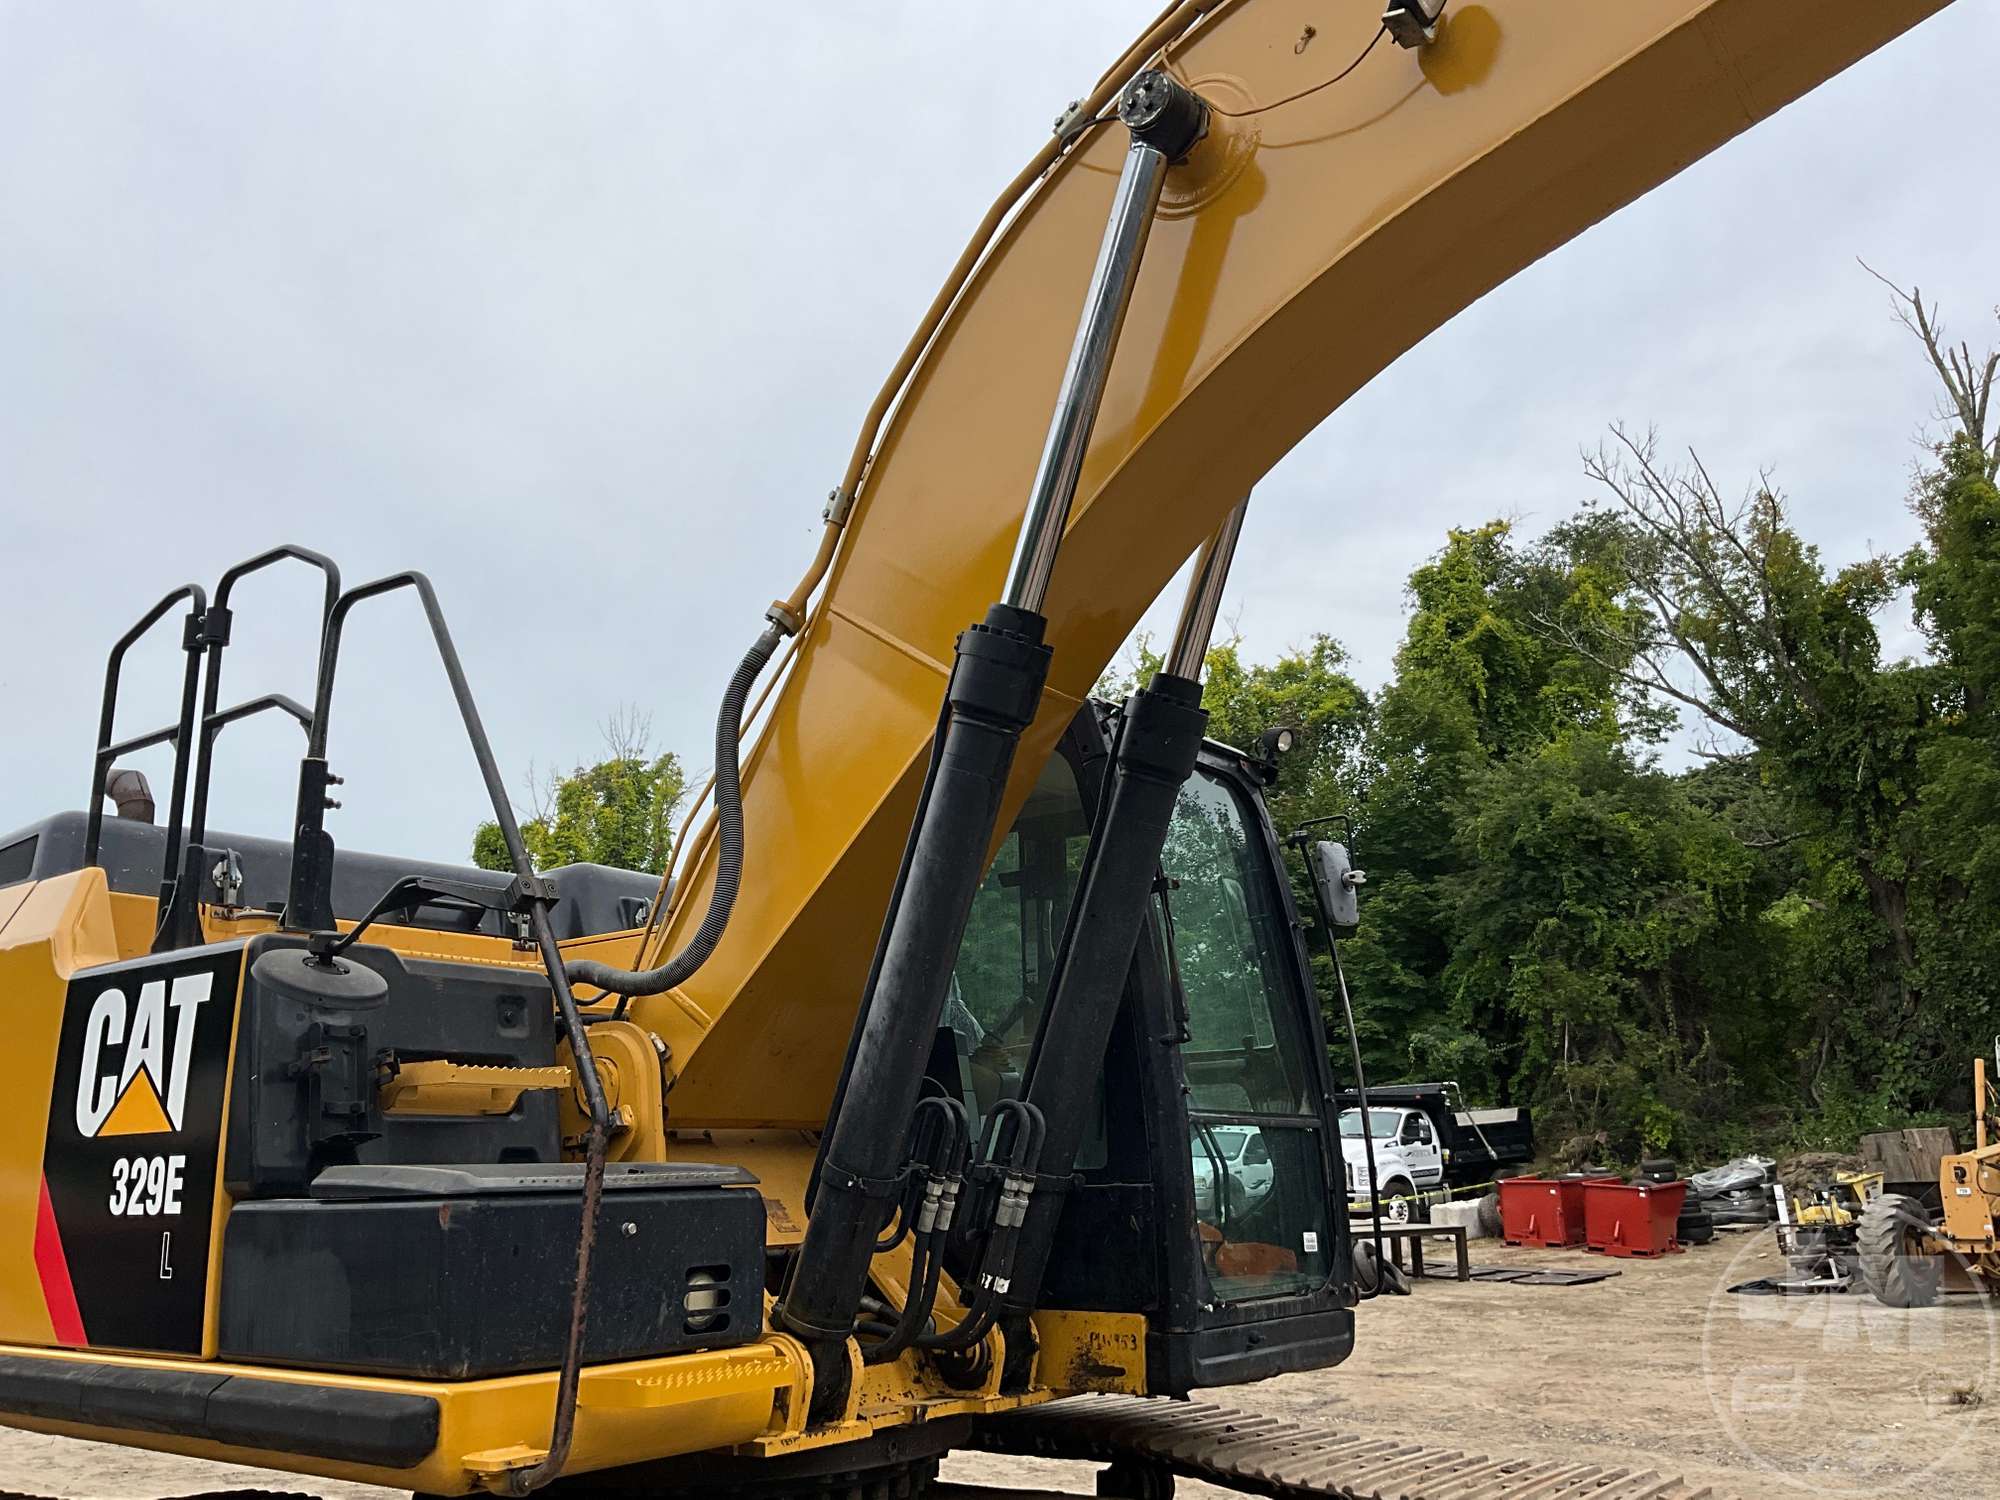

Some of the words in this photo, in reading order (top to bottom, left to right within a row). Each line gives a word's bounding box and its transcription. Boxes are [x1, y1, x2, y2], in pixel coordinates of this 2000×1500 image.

[76, 972, 214, 1138] CAT
[109, 1155, 185, 1216] 329E
[160, 1232, 172, 1279] L
